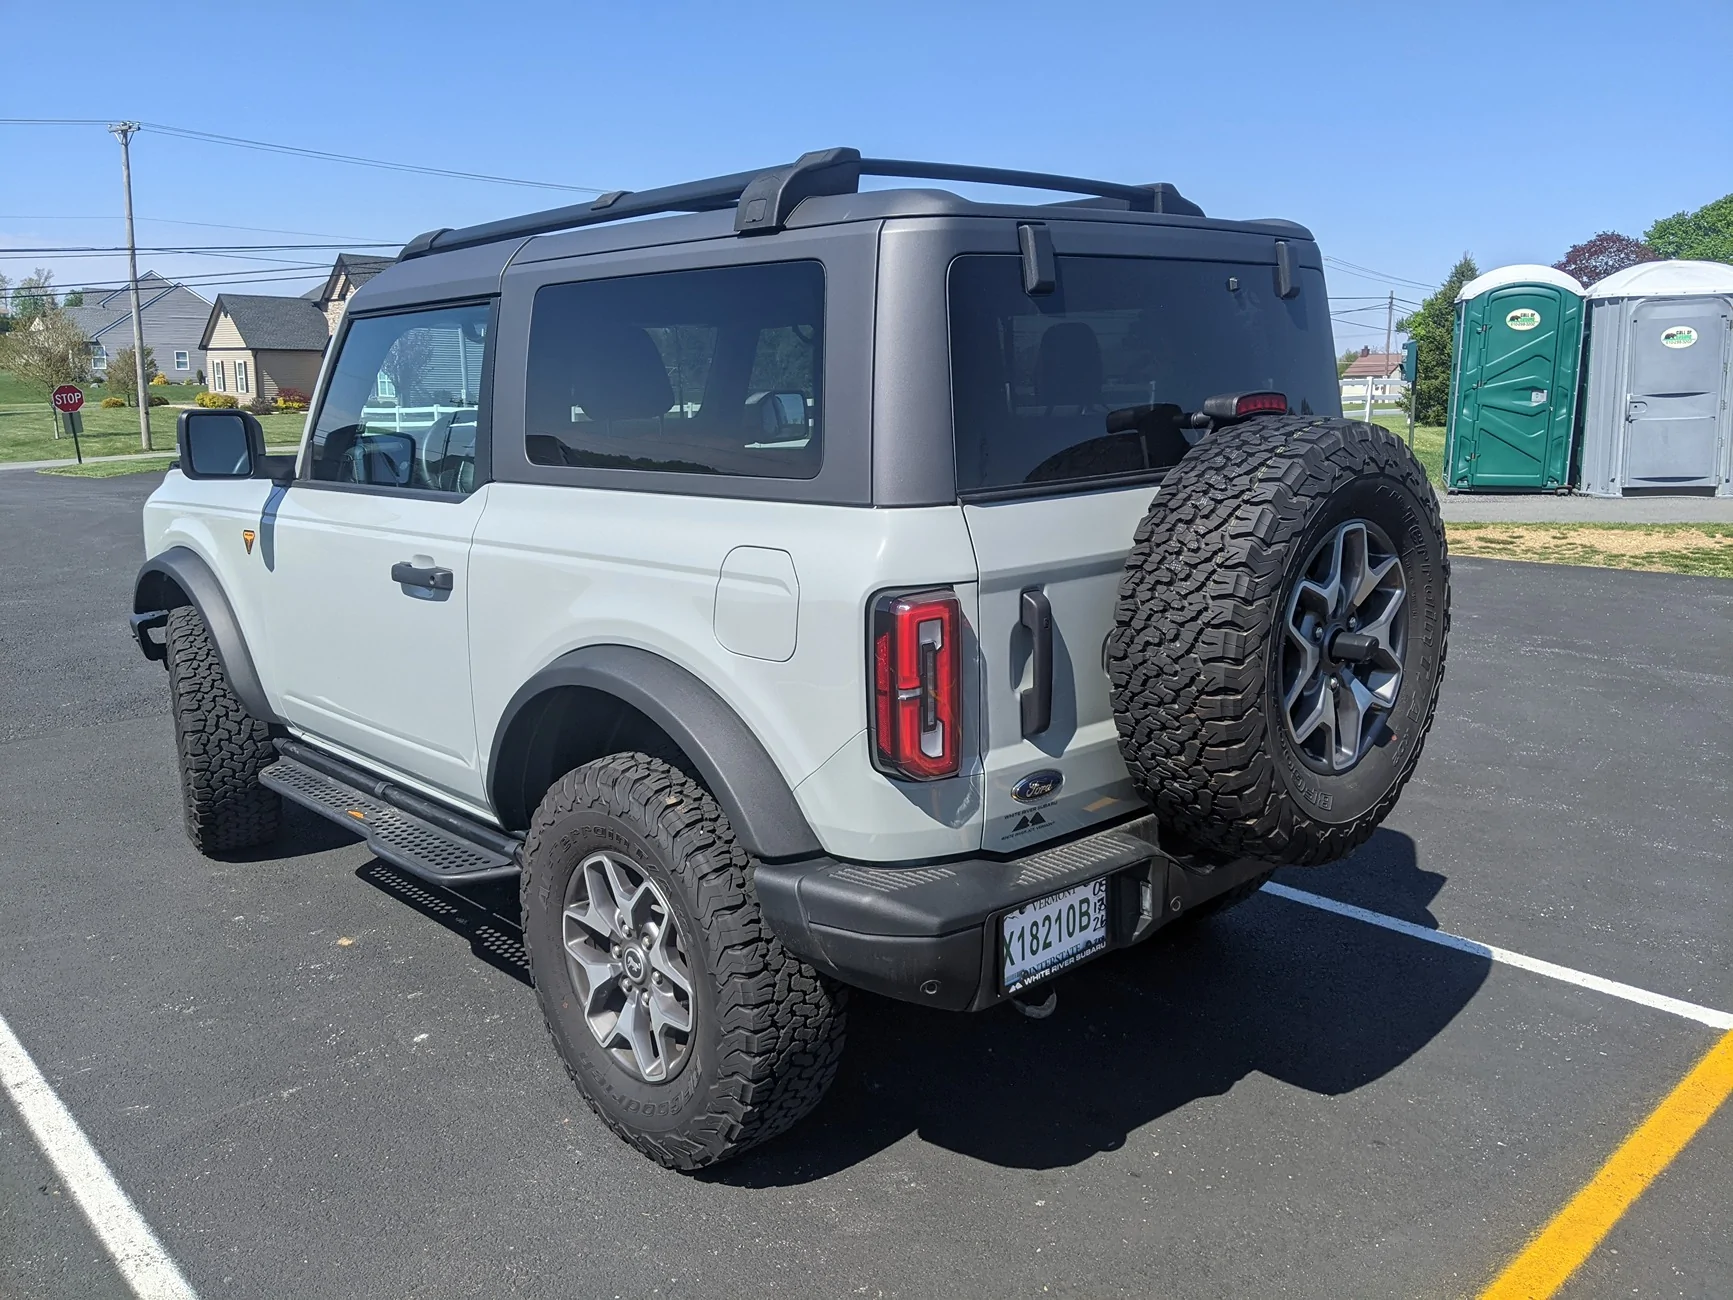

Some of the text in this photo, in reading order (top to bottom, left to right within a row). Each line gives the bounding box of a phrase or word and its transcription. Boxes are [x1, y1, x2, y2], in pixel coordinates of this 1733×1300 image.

[55, 392, 82, 405] STOP
[1026, 779, 1053, 798] Ford
[1004, 800, 1058, 820] WHITE RIVER SUBARU
[1032, 887, 1077, 912] VERMONT
[1004, 896, 1091, 967] X18210B
[1024, 941, 1107, 986] WHITE RIVER SUBARU
